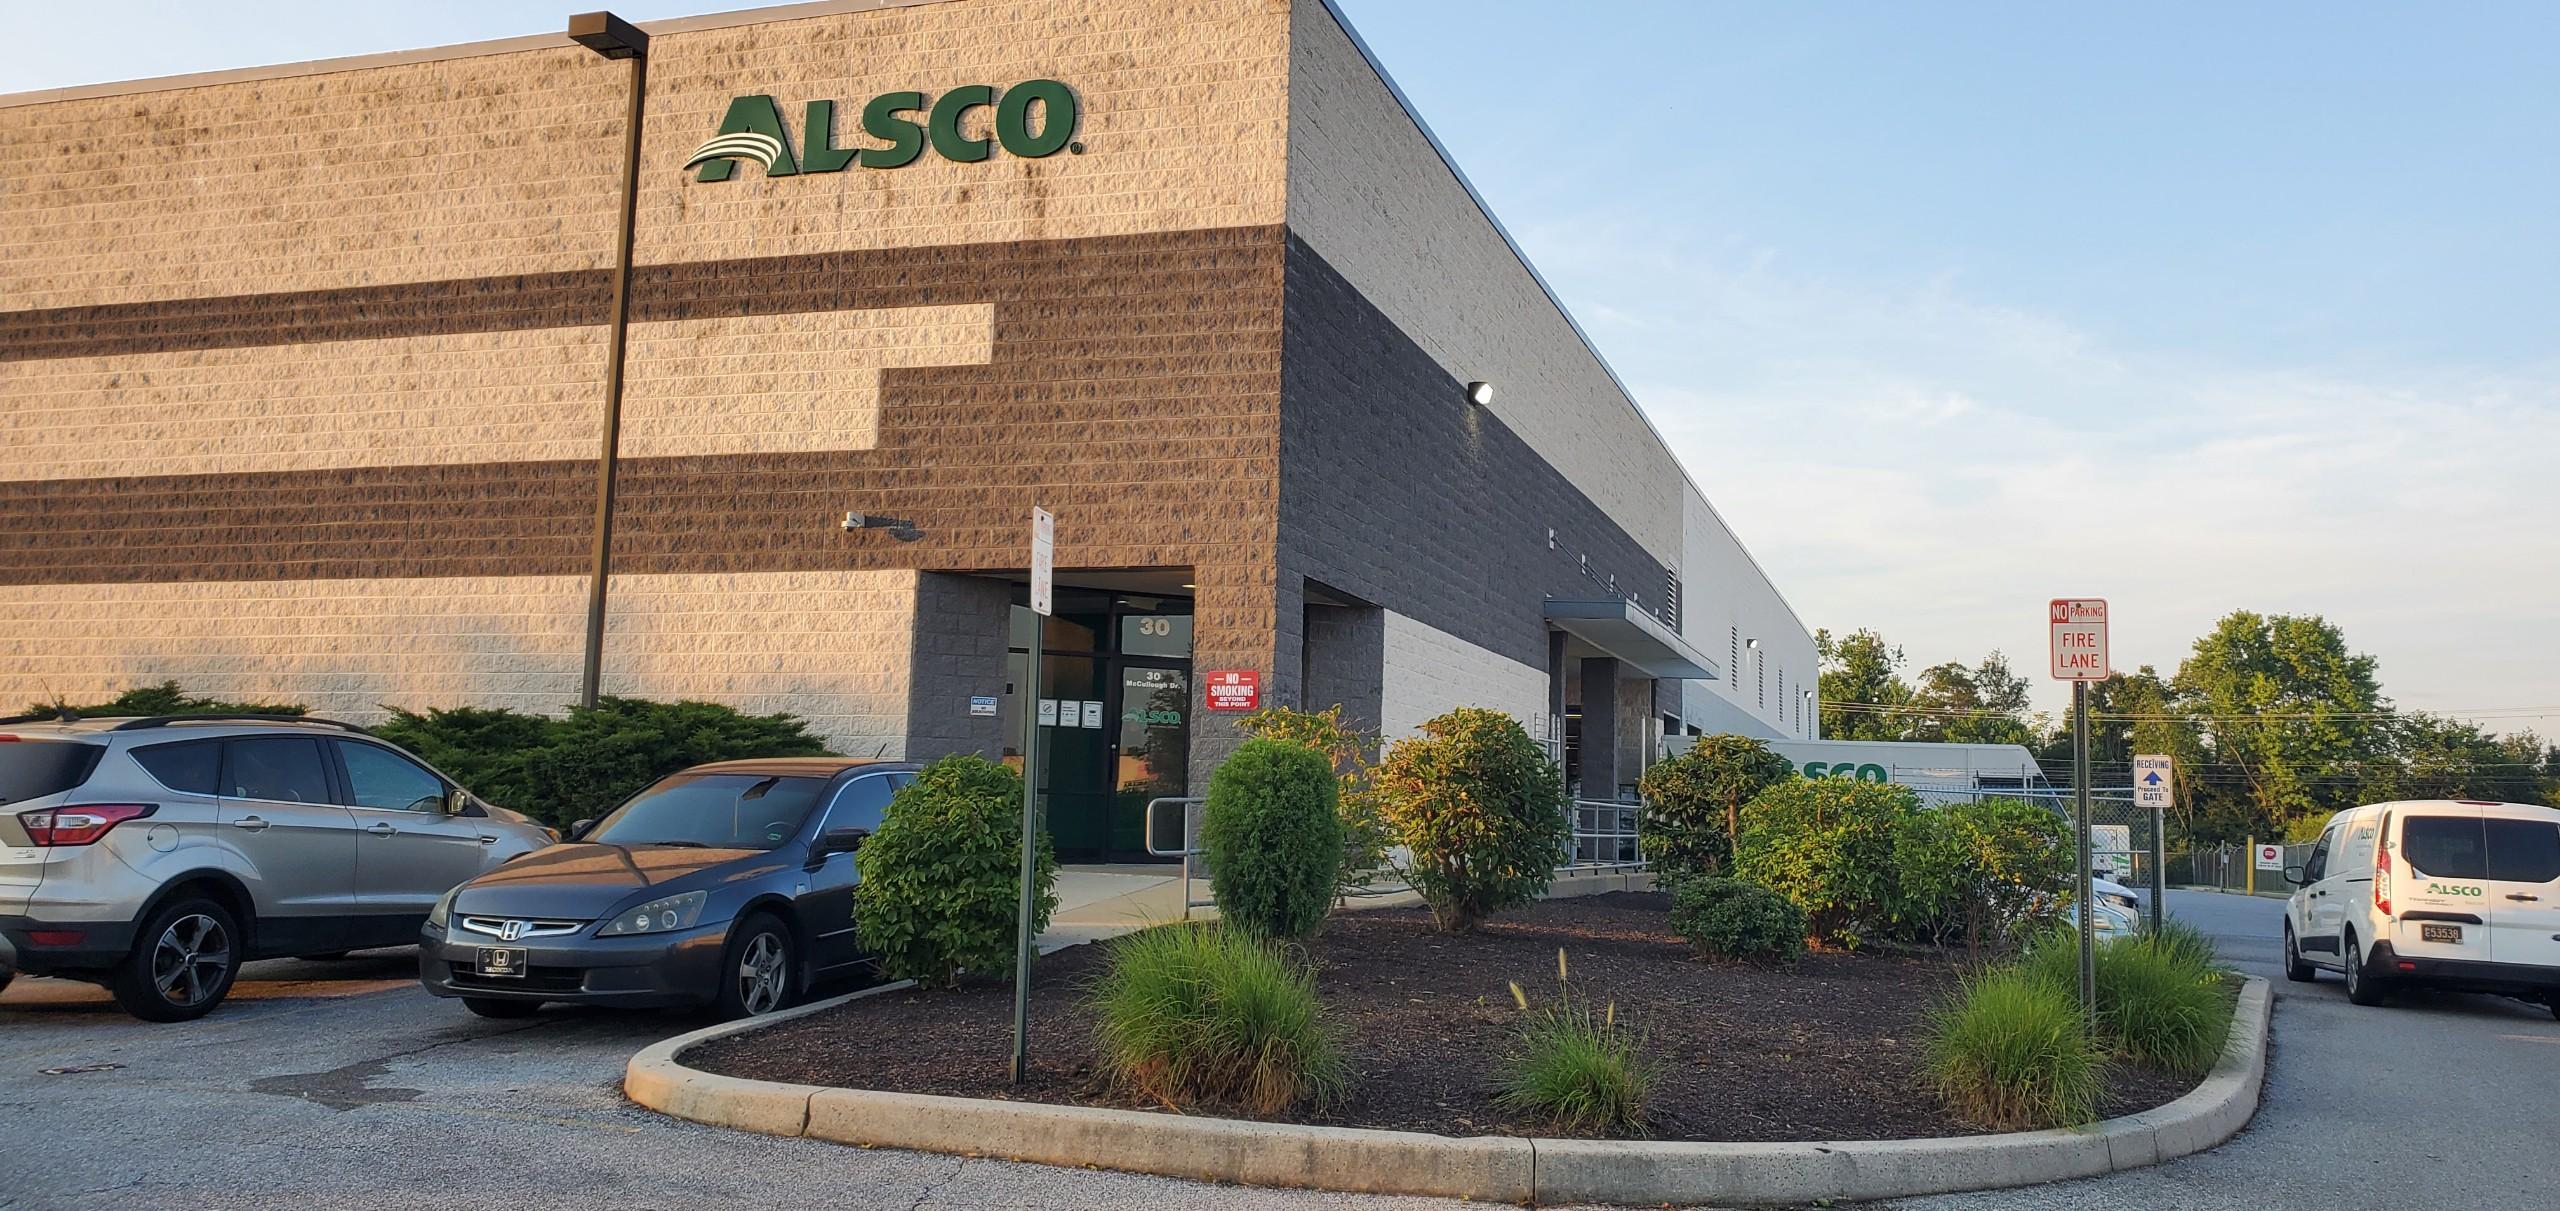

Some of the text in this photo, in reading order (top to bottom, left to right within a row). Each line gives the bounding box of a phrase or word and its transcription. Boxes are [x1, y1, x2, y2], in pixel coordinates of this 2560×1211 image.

[684, 79, 1076, 183] ALSCO
[2052, 604, 2103, 620] NO PARKING
[1140, 617, 1170, 636] 30
[2063, 632, 2096, 647] FIRE
[2060, 653, 2100, 668] LANE
[1146, 671, 1161, 681] 30
[1225, 673, 1239, 684] NO
[1210, 685, 1254, 697] SMOKING
[2136, 759, 2169, 769] RECEIVING
[2143, 793, 2164, 801] GATE
[2427, 883, 2482, 897] ALSCO
